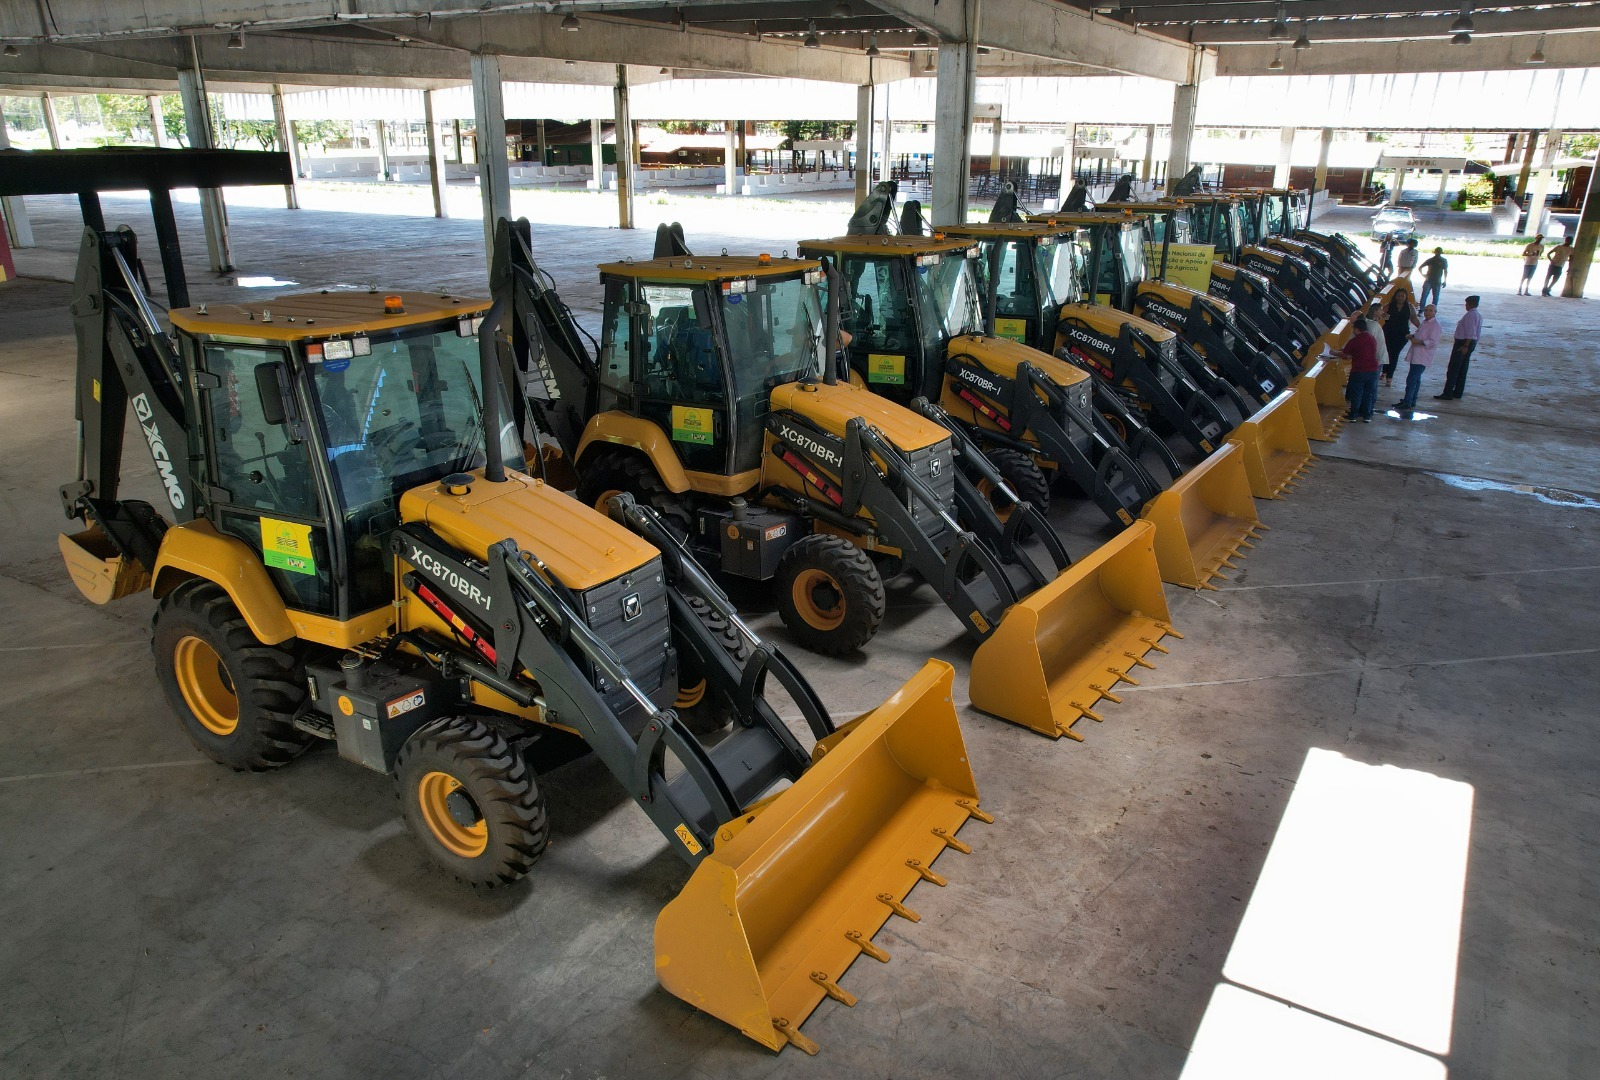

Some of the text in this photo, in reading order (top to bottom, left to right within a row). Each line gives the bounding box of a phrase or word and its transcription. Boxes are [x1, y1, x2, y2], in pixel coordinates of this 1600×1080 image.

[1209, 280, 1231, 292] 70BR-I
[1146, 301, 1187, 323] XC870BR-I
[1070, 329, 1116, 354] XC870BR-I
[959, 368, 1002, 395] XC870BR-I
[780, 425, 843, 468] XC870BR-I
[141, 421, 185, 510] XCMG
[411, 545, 492, 611] XC870BR-I
